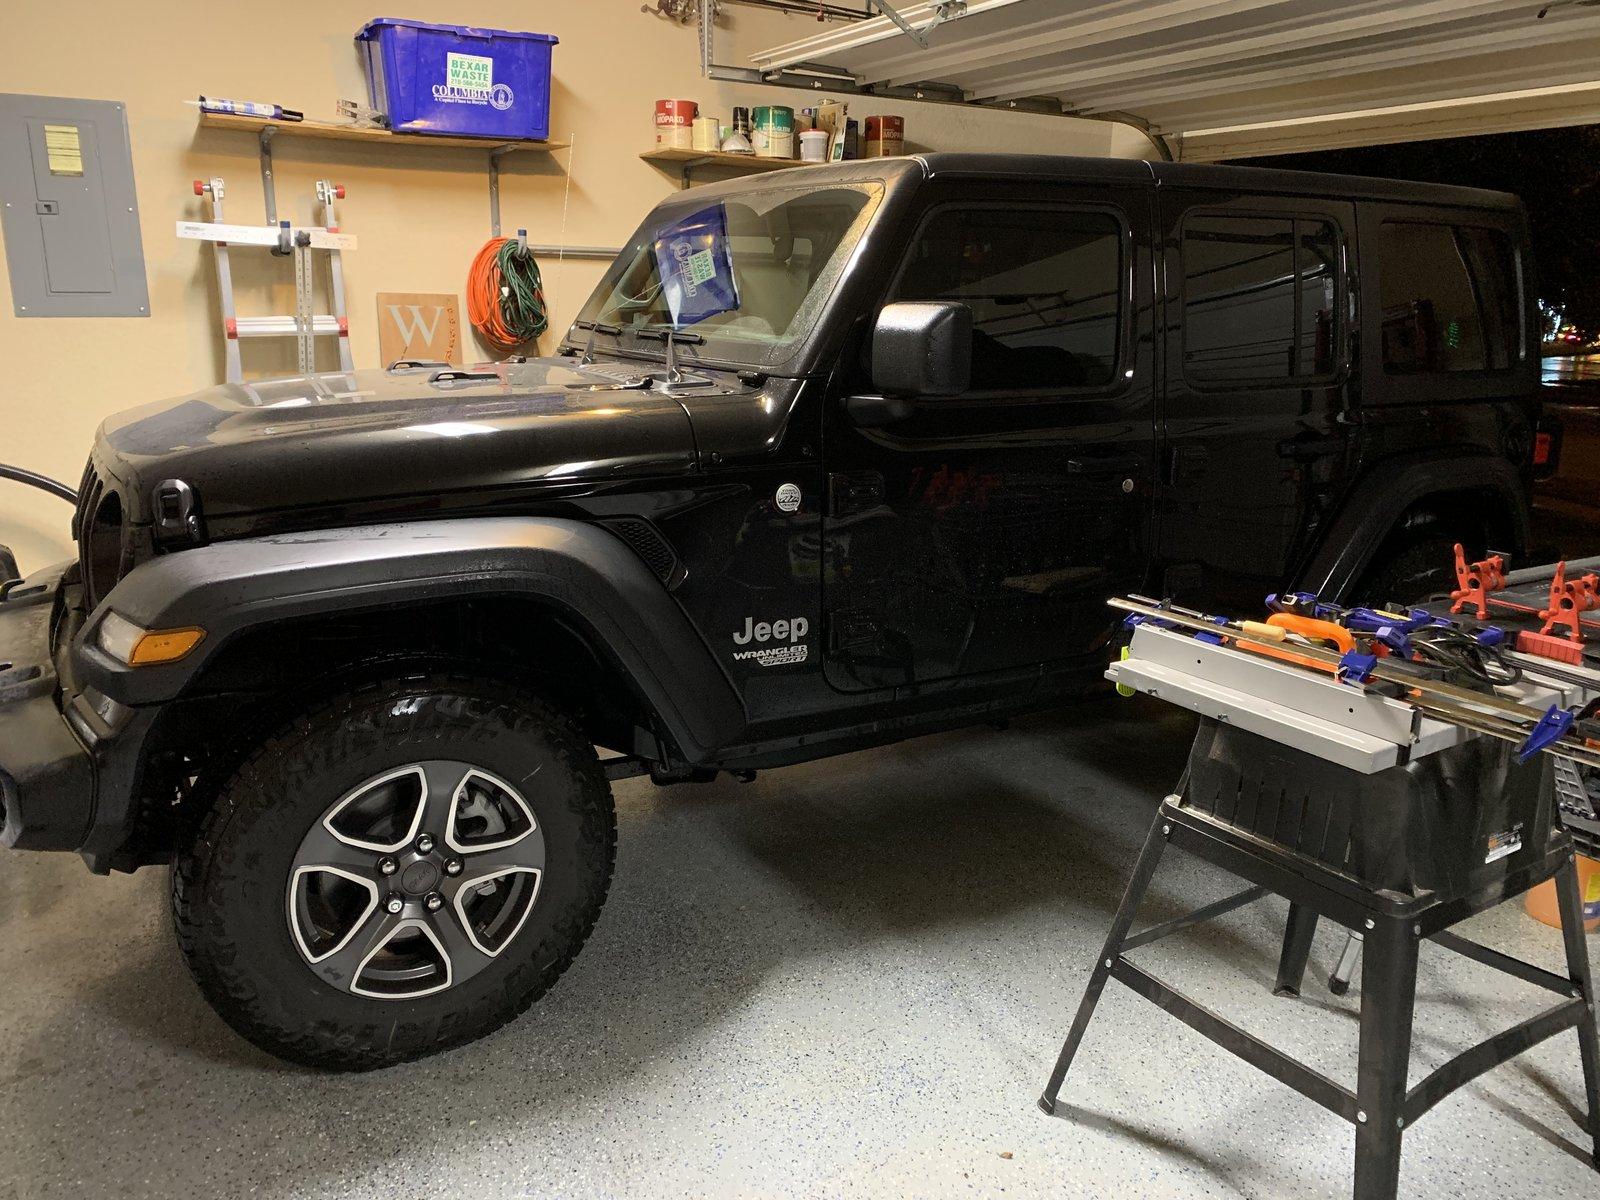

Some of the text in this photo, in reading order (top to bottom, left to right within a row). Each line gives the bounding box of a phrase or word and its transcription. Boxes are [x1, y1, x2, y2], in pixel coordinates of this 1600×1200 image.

[451, 60, 489, 73] BEXAR
[451, 69, 489, 82] WASTE
[432, 84, 490, 99] COLUMBIA
[385, 304, 445, 349] W
[732, 616, 809, 645] Jeep
[732, 644, 808, 661] WRANGLER
